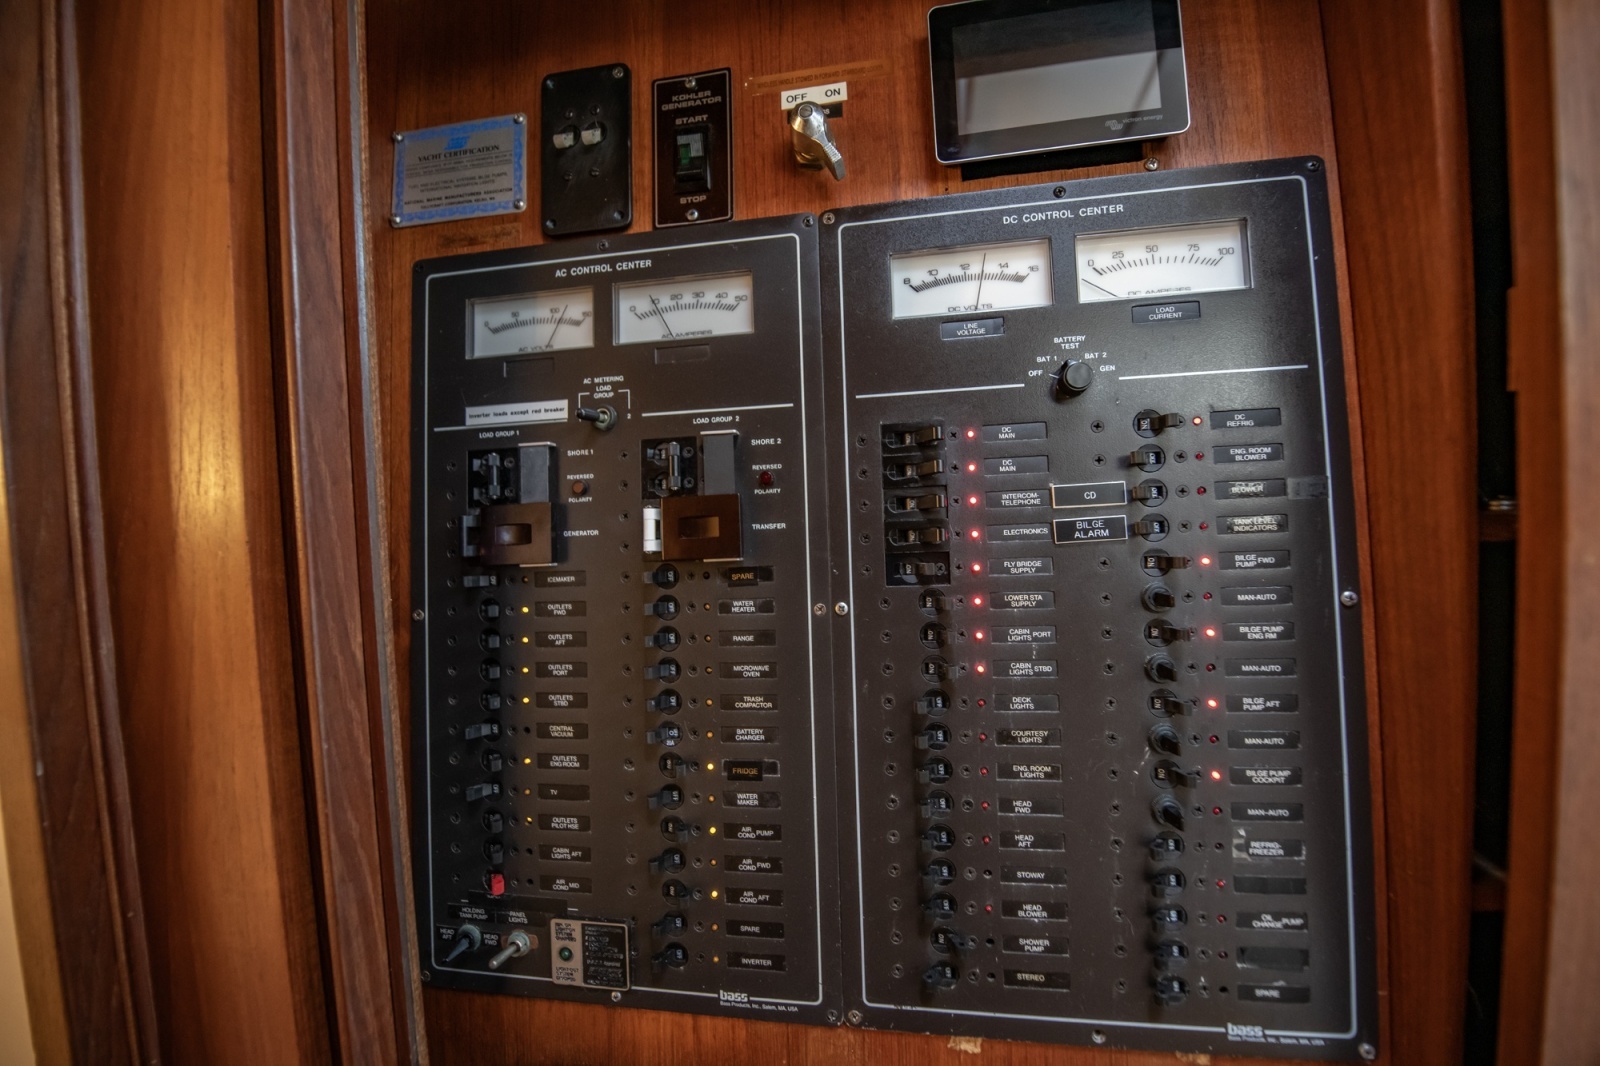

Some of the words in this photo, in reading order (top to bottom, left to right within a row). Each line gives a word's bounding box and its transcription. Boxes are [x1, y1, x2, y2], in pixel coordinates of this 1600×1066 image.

[672, 90, 712, 102] KOHLER
[786, 92, 808, 103] OFF
[824, 88, 841, 98] ON
[661, 96, 722, 111] GENERATOR
[675, 114, 708, 125] START
[1122, 115, 1142, 124] victron
[418, 153, 442, 162] YACHT
[443, 144, 500, 159] CERTIFICATION
[680, 195, 707, 205] STOP
[1003, 215, 1018, 225] DC
[1022, 208, 1074, 223] CONTROL
[1078, 204, 1124, 217] CENTER
[1145, 245, 1159, 253] 50
[1187, 244, 1200, 252] 75
[1218, 247, 1235, 255] 100
[1112, 250, 1124, 259] 25
[555, 268, 567, 278] AC
[570, 263, 612, 276] CONTROL
[616, 259, 652, 271] CENTER
[691, 291, 705, 299] 30
[715, 292, 728, 300] 40
[1148, 312, 1183, 320] CURRENT
[956, 328, 986, 336] VOLTAGE
[1053, 335, 1086, 344] BATTERY
[593, 375, 624, 384] METERING
[711, 416, 733, 424] GROUP
[1084, 491, 1096, 500] CD
[1076, 520, 1105, 530] BILGE
[563, 529, 599, 537] GENERATOR
[1003, 528, 1048, 536] ELECTRONICS
[1074, 529, 1110, 539] ALARM
[1247, 808, 1289, 817] MAN-AUTO
[741, 958, 772, 966] INVERTER
[1016, 973, 1045, 982] STEREO
[719, 989, 748, 1002] bass
[1227, 1022, 1263, 1037] bass
